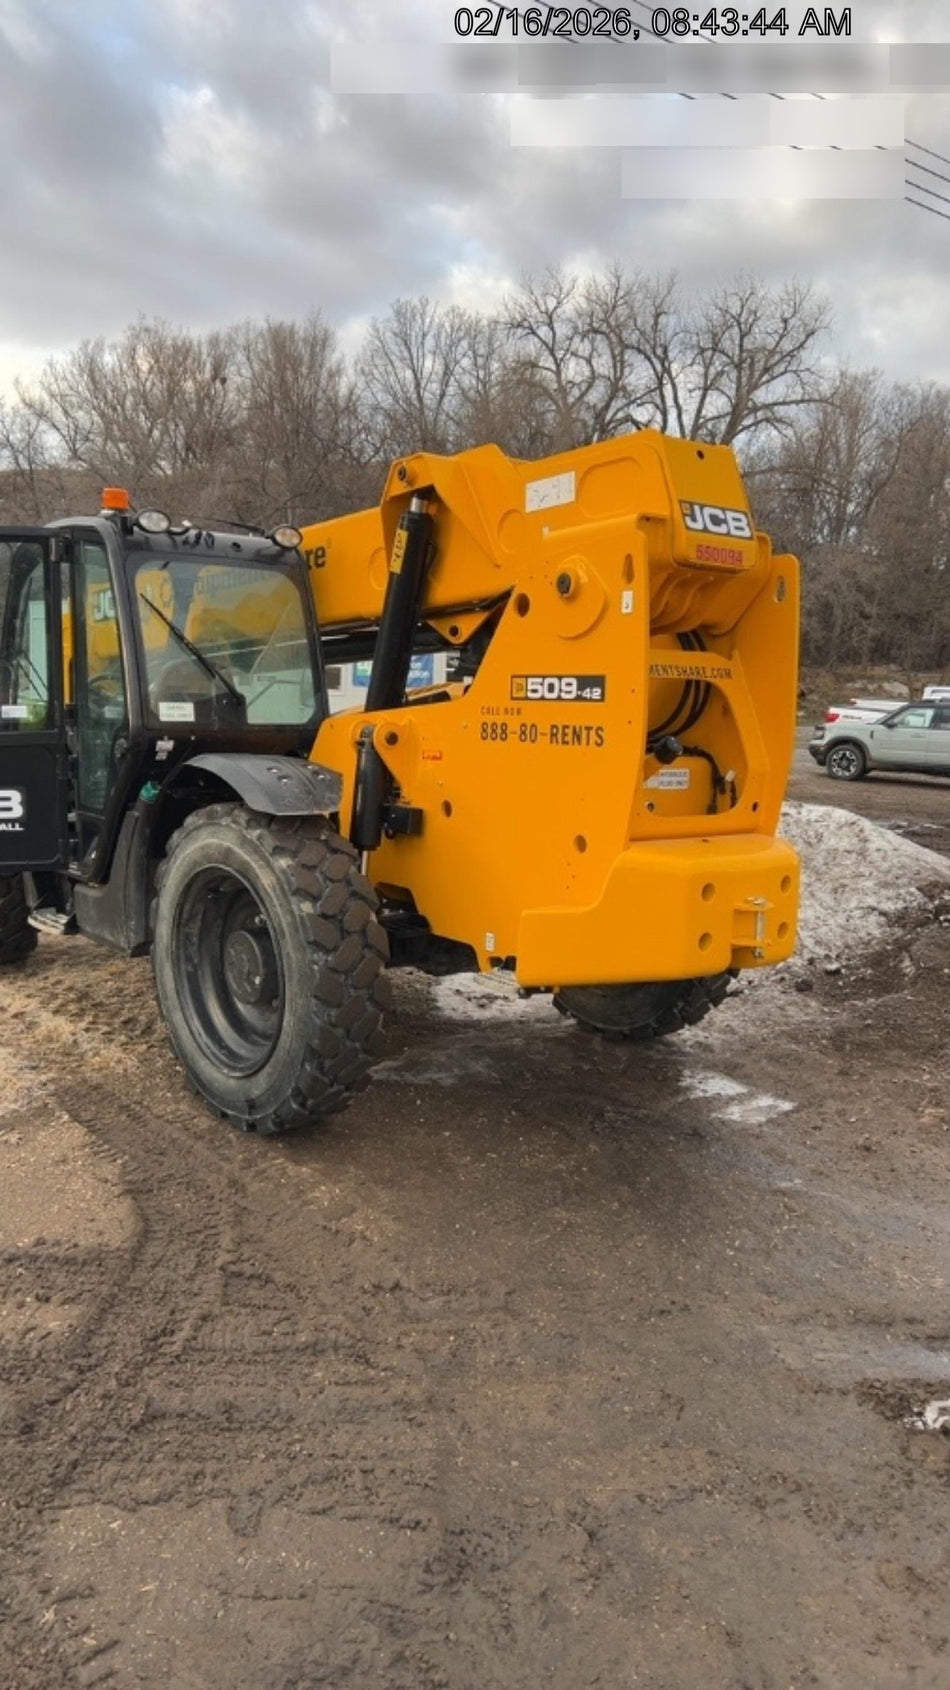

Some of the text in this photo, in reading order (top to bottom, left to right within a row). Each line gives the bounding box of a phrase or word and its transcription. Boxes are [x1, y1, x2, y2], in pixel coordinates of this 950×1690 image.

[685, 504, 752, 538] JCB
[481, 705, 522, 717] CALL NOW
[480, 721, 604, 747] 888-80-RENTS
